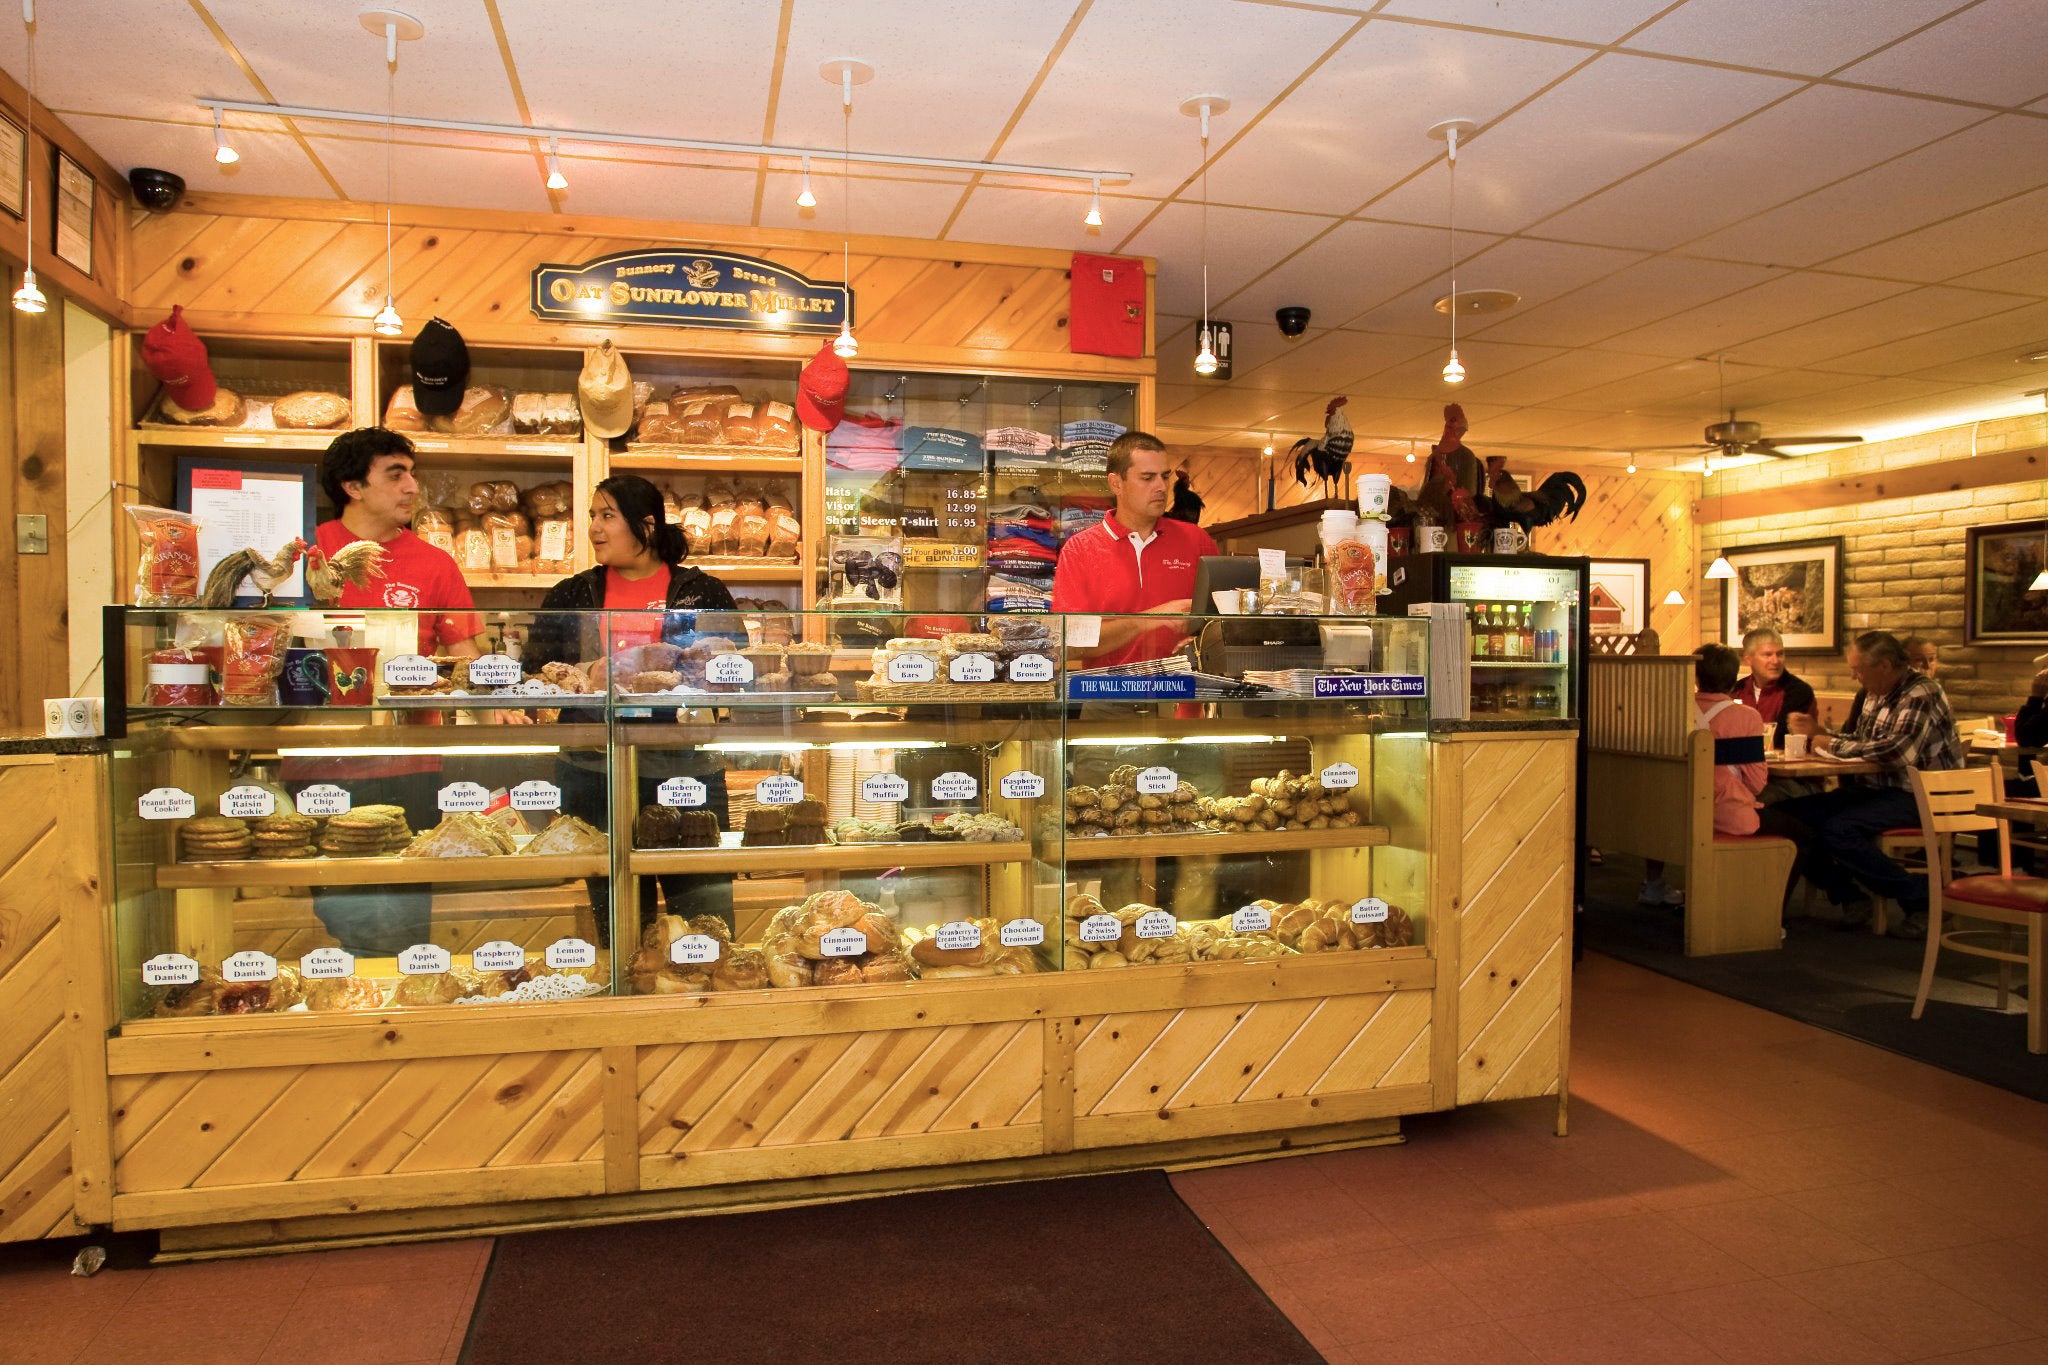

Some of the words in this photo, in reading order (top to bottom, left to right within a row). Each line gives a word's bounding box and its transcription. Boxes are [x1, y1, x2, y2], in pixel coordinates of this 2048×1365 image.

[615, 262, 676, 279] Bunnery
[732, 267, 777, 287] Bread
[550, 277, 605, 303] OAT
[610, 281, 749, 307] SUNFLOWER
[749, 289, 836, 314] MILLET
[1089, 421, 1116, 430] BUNNERY
[825, 487, 851, 497] Hats
[946, 489, 976, 499] 16.85
[825, 501, 856, 511] Visor
[946, 503, 977, 513] 12.99
[825, 515, 858, 526] Short
[860, 515, 898, 526] Sleeve
[901, 516, 939, 527] T-shirt
[947, 518, 976, 527] 16.95
[914, 548, 931, 556] Your
[953, 546, 978, 555] 1.00
[153, 551, 198, 569] GRANOLA
[470, 663, 509, 671] Blueberry
[716, 661, 743, 669] Coffee
[395, 674, 427, 682] Cookie
[475, 670, 518, 678] Raspberry
[1080, 681, 1098, 693] THE
[1099, 681, 1121, 693] WALL
[1121, 681, 1151, 692] STREET
[1317, 678, 1338, 693] The
[1339, 678, 1362, 693] New
[1363, 676, 1390, 695] York
[1391, 678, 1424, 693] Times
[761, 781, 799, 789] Pumpkin
[1003, 778, 1043, 786] Raspberry
[661, 784, 702, 792] Blueberry
[866, 782, 906, 791] Blueberry
[451, 790, 477, 798] Apple
[513, 790, 558, 799] Raspberry
[769, 788, 792, 796] Apple
[227, 793, 267, 801] Oatmeal
[168, 798, 192, 806] Butter
[313, 798, 334, 806] Chip
[444, 799, 485, 807] Turnover
[516, 798, 556, 806] Turnover
[307, 806, 340, 814] Cookie
[1144, 917, 1169, 925] Turkey
[1235, 923, 1267, 931] Croissant
[1083, 933, 1118, 941] Croissant
[1139, 929, 1173, 937] Croissant
[1004, 935, 1040, 943] Croissant
[682, 943, 708, 951] Sticky
[412, 953, 437, 961] Apple
[476, 950, 521, 959] Raspberry
[310, 957, 344, 965] Cheese
[483, 959, 514, 967] Danish
[555, 956, 586, 964] Danish
[146, 963, 194, 972] Blueberry
[233, 960, 265, 969] Cherry
[409, 962, 440, 970] Danish
[233, 969, 267, 978] Danish
[311, 966, 343, 975] Danish
[154, 973, 188, 981] Danish
